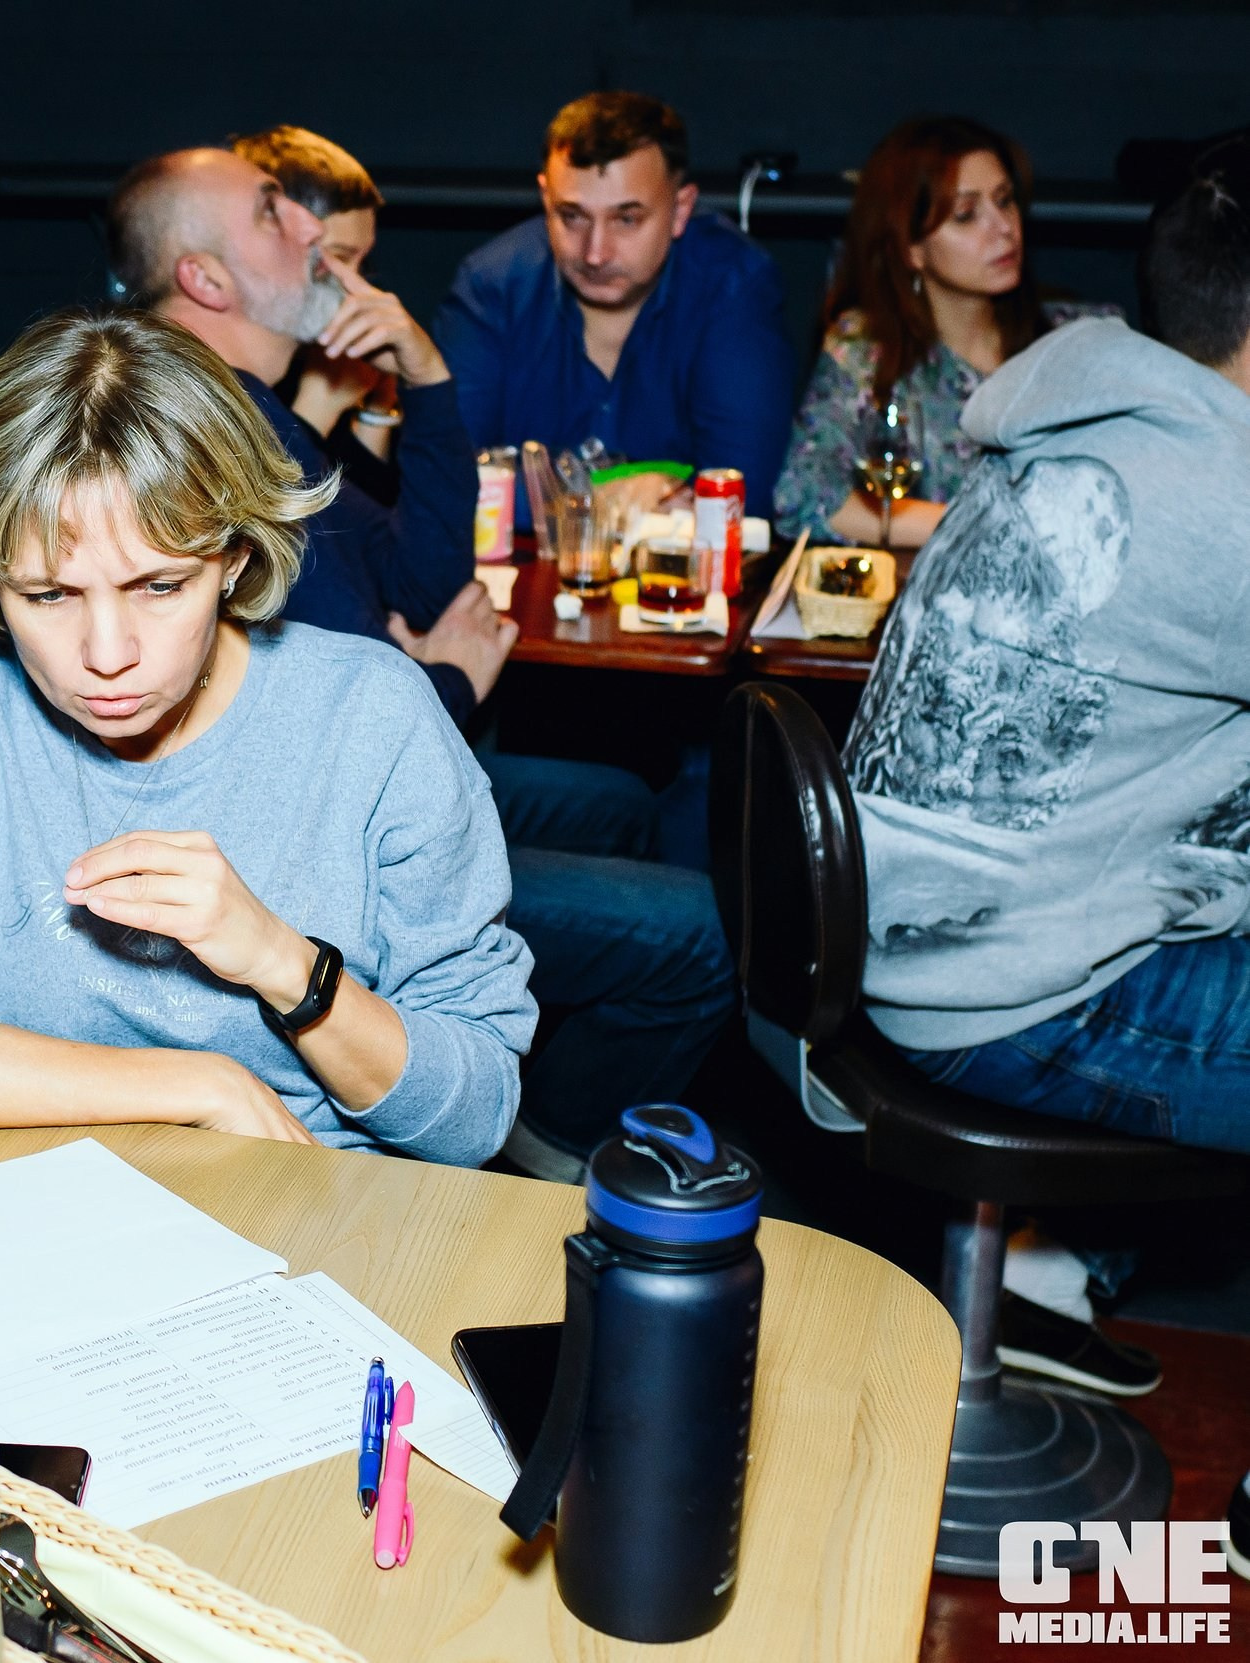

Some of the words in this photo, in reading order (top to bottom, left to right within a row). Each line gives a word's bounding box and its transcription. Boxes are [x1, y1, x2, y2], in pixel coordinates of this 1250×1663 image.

[134, 1004, 158, 1018] and
[194, 1294, 252, 1313] Корпорация
[147, 1312, 192, 1327] монстров
[191, 1302, 264, 1326] Пластилиновая
[208, 1310, 276, 1333] Суперсемейка
[156, 1324, 189, 1337] ворона
[231, 1320, 287, 1339] музыкантов
[248, 1330, 281, 1343] следам
[85, 1336, 116, 1347] Didn't
[108, 1340, 145, 1352] Эдуард
[267, 1334, 310, 1350] Ходячий
[36, 1354, 58, 1362] You
[58, 1345, 84, 1355] Have
[122, 1349, 157, 1361] Майкл
[190, 1342, 248, 1362] бременских
[238, 1348, 265, 1360] замок
[269, 1344, 324, 1363] Винни-Пух
[52, 1351, 108, 1370] Успенский
[70, 1358, 121, 1377] Джаккино
[206, 1358, 238, 1370] Хаула
[280, 1353, 338, 1374] Мадагаскар
[129, 1364, 178, 1383] Геннадий
[208, 1372, 235, 1384] гости
[302, 1362, 350, 1380] Крокодил
[86, 1380, 129, 1396] Гладков
[126, 1380, 170, 1397] Хисаиси
[278, 1378, 302, 1388] Гена
[316, 1372, 364, 1389] Холодное
[160, 1384, 204, 1400] Евгений
[281, 1388, 314, 1401] сердце
[121, 1398, 158, 1412] Леонов
[174, 1400, 194, 1410] And
[177, 1402, 229, 1422] Владимир
[136, 1408, 174, 1421] Chunky
[224, 1412, 243, 1420] Let
[187, 1422, 256, 1448] Колыбельная
[124, 1446, 187, 1469] Медведицы
[205, 1443, 234, 1456] Джон
[195, 1460, 237, 1476] Смотри
[148, 1480, 175, 1492] экран
[204, 1472, 248, 1488] Ответы
